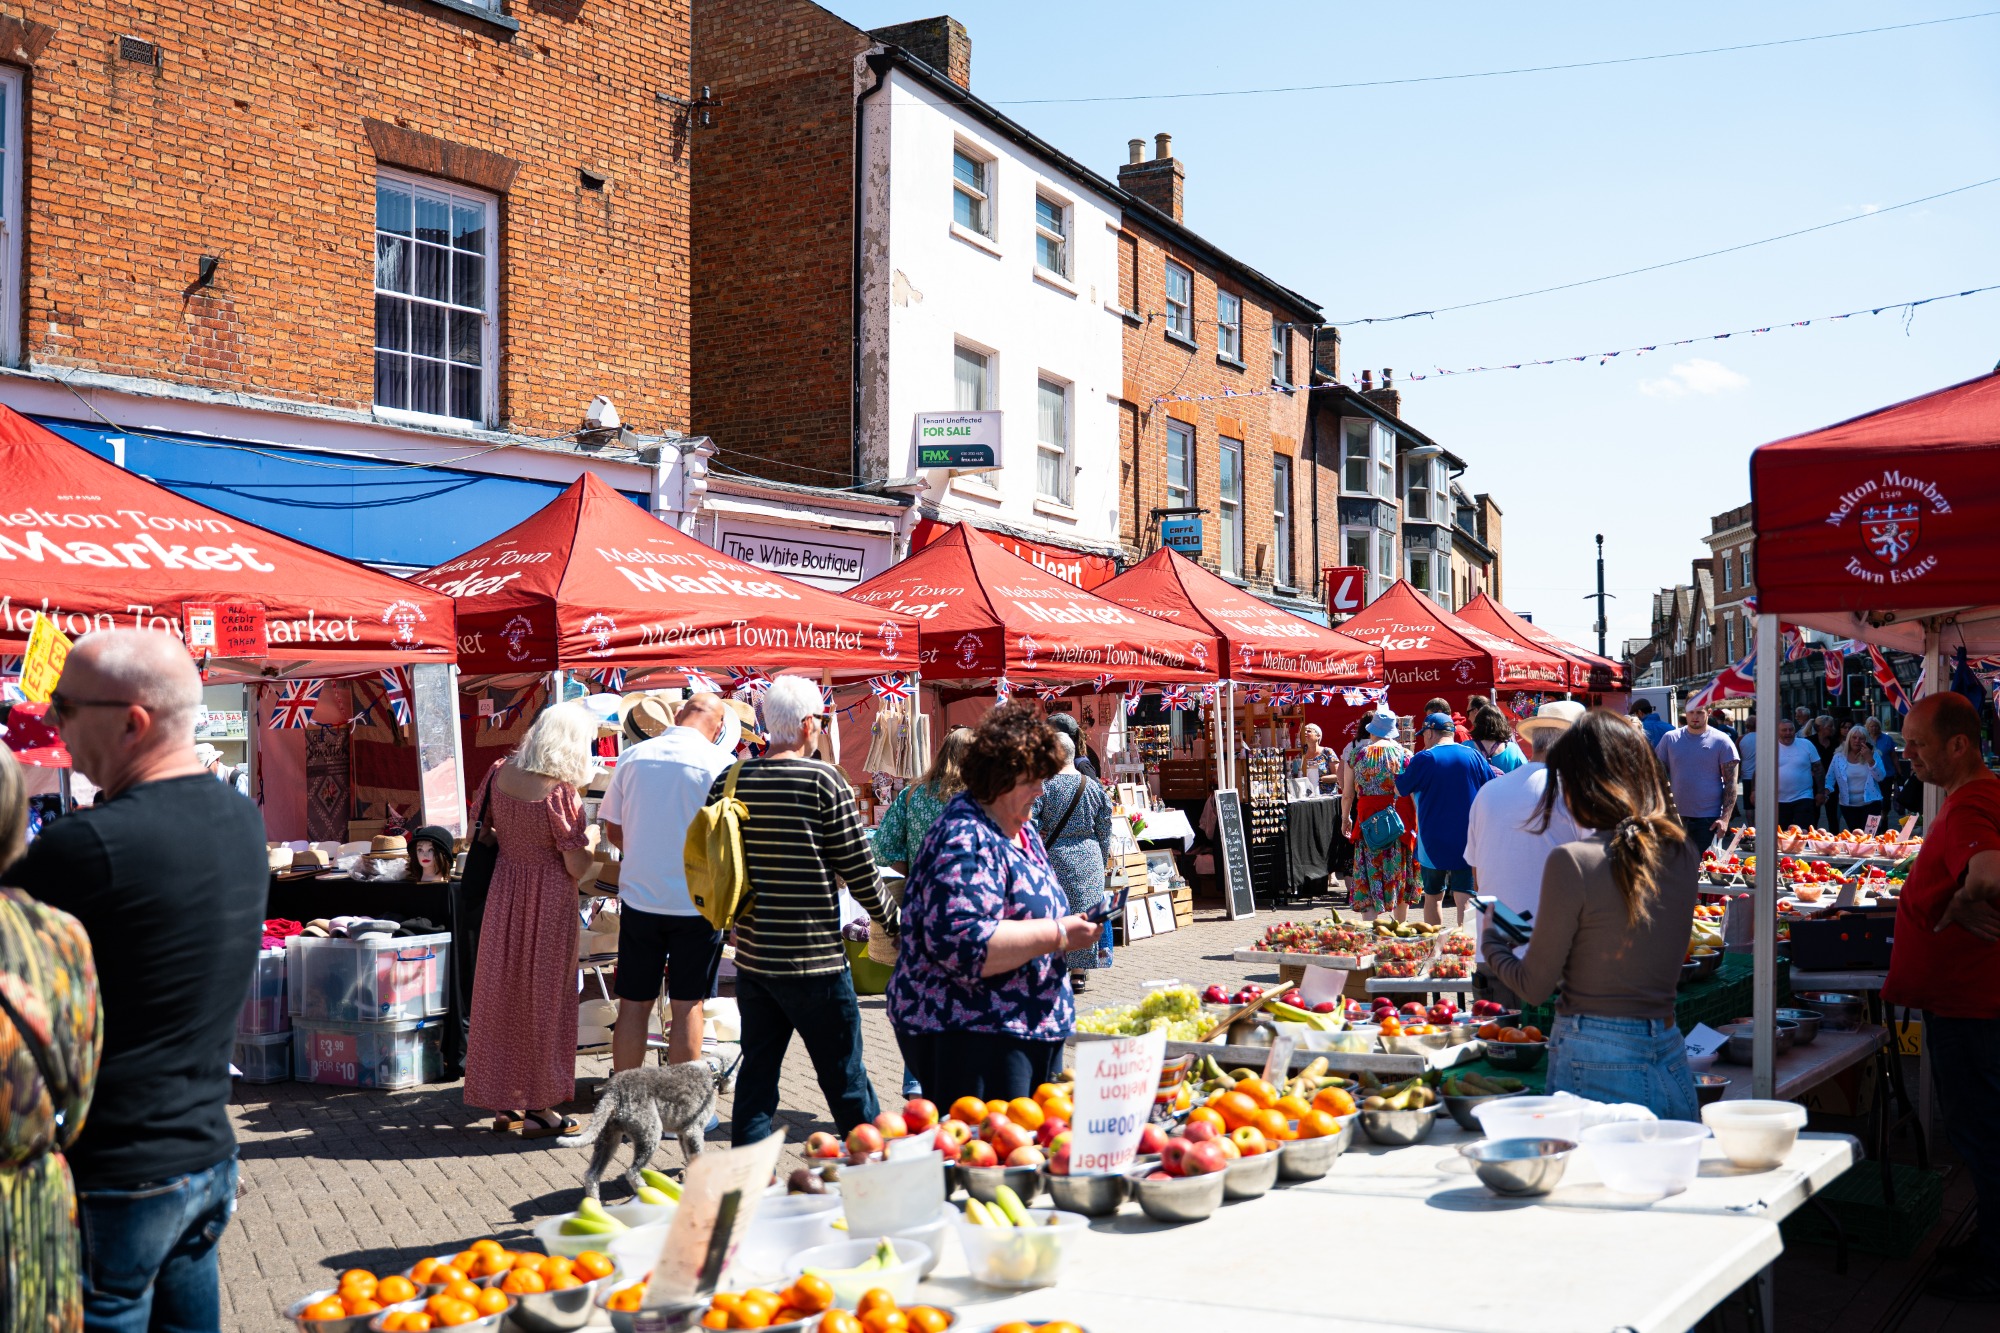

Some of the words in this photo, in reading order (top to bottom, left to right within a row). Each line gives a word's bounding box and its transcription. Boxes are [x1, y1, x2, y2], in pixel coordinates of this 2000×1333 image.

[923, 427, 945, 436] FOR
[946, 426, 971, 436] SALE
[946, 416, 982, 424] Unaffected
[1825, 479, 1878, 527] Melton
[1882, 470, 1953, 516] Mowbray
[1880, 490, 1902, 500] 1549
[116, 509, 236, 533] Town
[1170, 525, 1194, 534] CAFFÈ
[0, 531, 276, 573] Market
[1164, 536, 1200, 546] NERO
[491, 550, 552, 566] Town
[595, 547, 695, 567] Melton
[691, 552, 762, 576] Town
[728, 540, 754, 562] The
[760, 544, 799, 567] White
[801, 549, 858, 574] Boutique
[1032, 551, 1083, 588] Heart
[1844, 556, 1885, 584] Town
[1890, 554, 1938, 584] Estate
[615, 566, 801, 601] Market
[909, 584, 965, 597] Town
[993, 586, 1054, 600] Melton
[228, 606, 247, 614] ALL
[1012, 601, 1136, 625] Market
[226, 625, 255, 633] CARDS
[264, 609, 361, 642] arket
[638, 622, 726, 648] Melton
[731, 620, 789, 648] Town
[794, 622, 864, 650] Market
[1390, 624, 1436, 633] Town
[227, 637, 257, 648] TAKEN
[50, 641, 67, 673] £9
[1050, 644, 1101, 664] Melton
[1104, 644, 1139, 665] Town
[1140, 648, 1186, 667] Market
[1262, 650, 1297, 671] Melton
[1299, 654, 1325, 674] Town
[1325, 658, 1359, 676] Market
[28, 658, 45, 693] £5
[1384, 666, 1441, 684] Market
[320, 1039, 344, 1058] £3.99
[319, 1062, 334, 1072] FOR
[336, 1062, 356, 1081] £10
[1095, 1056, 1153, 1079] Country
